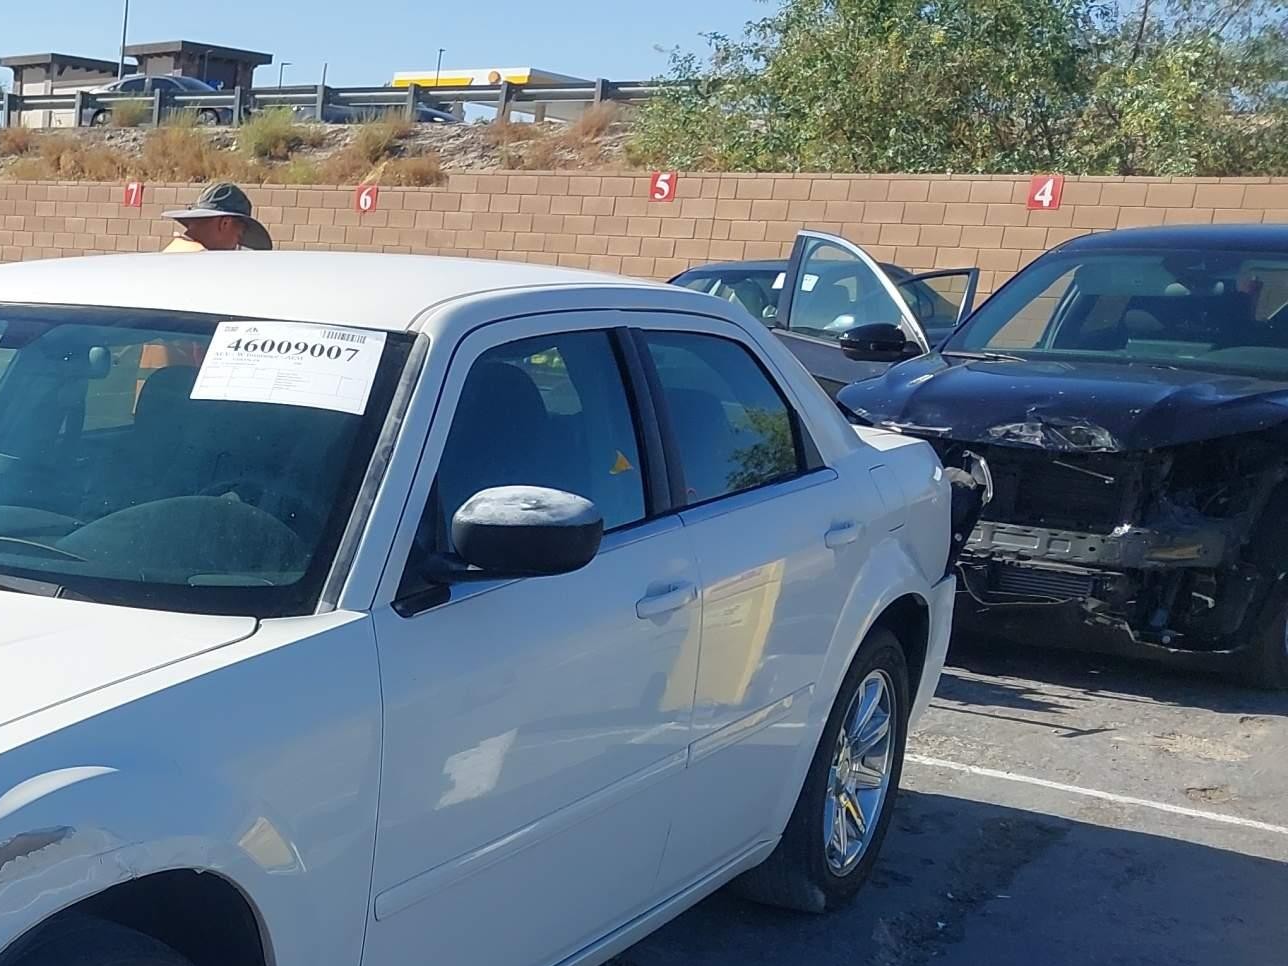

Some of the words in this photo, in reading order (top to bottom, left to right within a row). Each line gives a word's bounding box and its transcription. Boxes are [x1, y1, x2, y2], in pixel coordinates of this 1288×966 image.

[128, 183, 138, 205] 7
[360, 187, 372, 210] 6
[654, 173, 671, 200] 5
[1034, 178, 1054, 207] 4
[227, 338, 360, 362] 46009007
